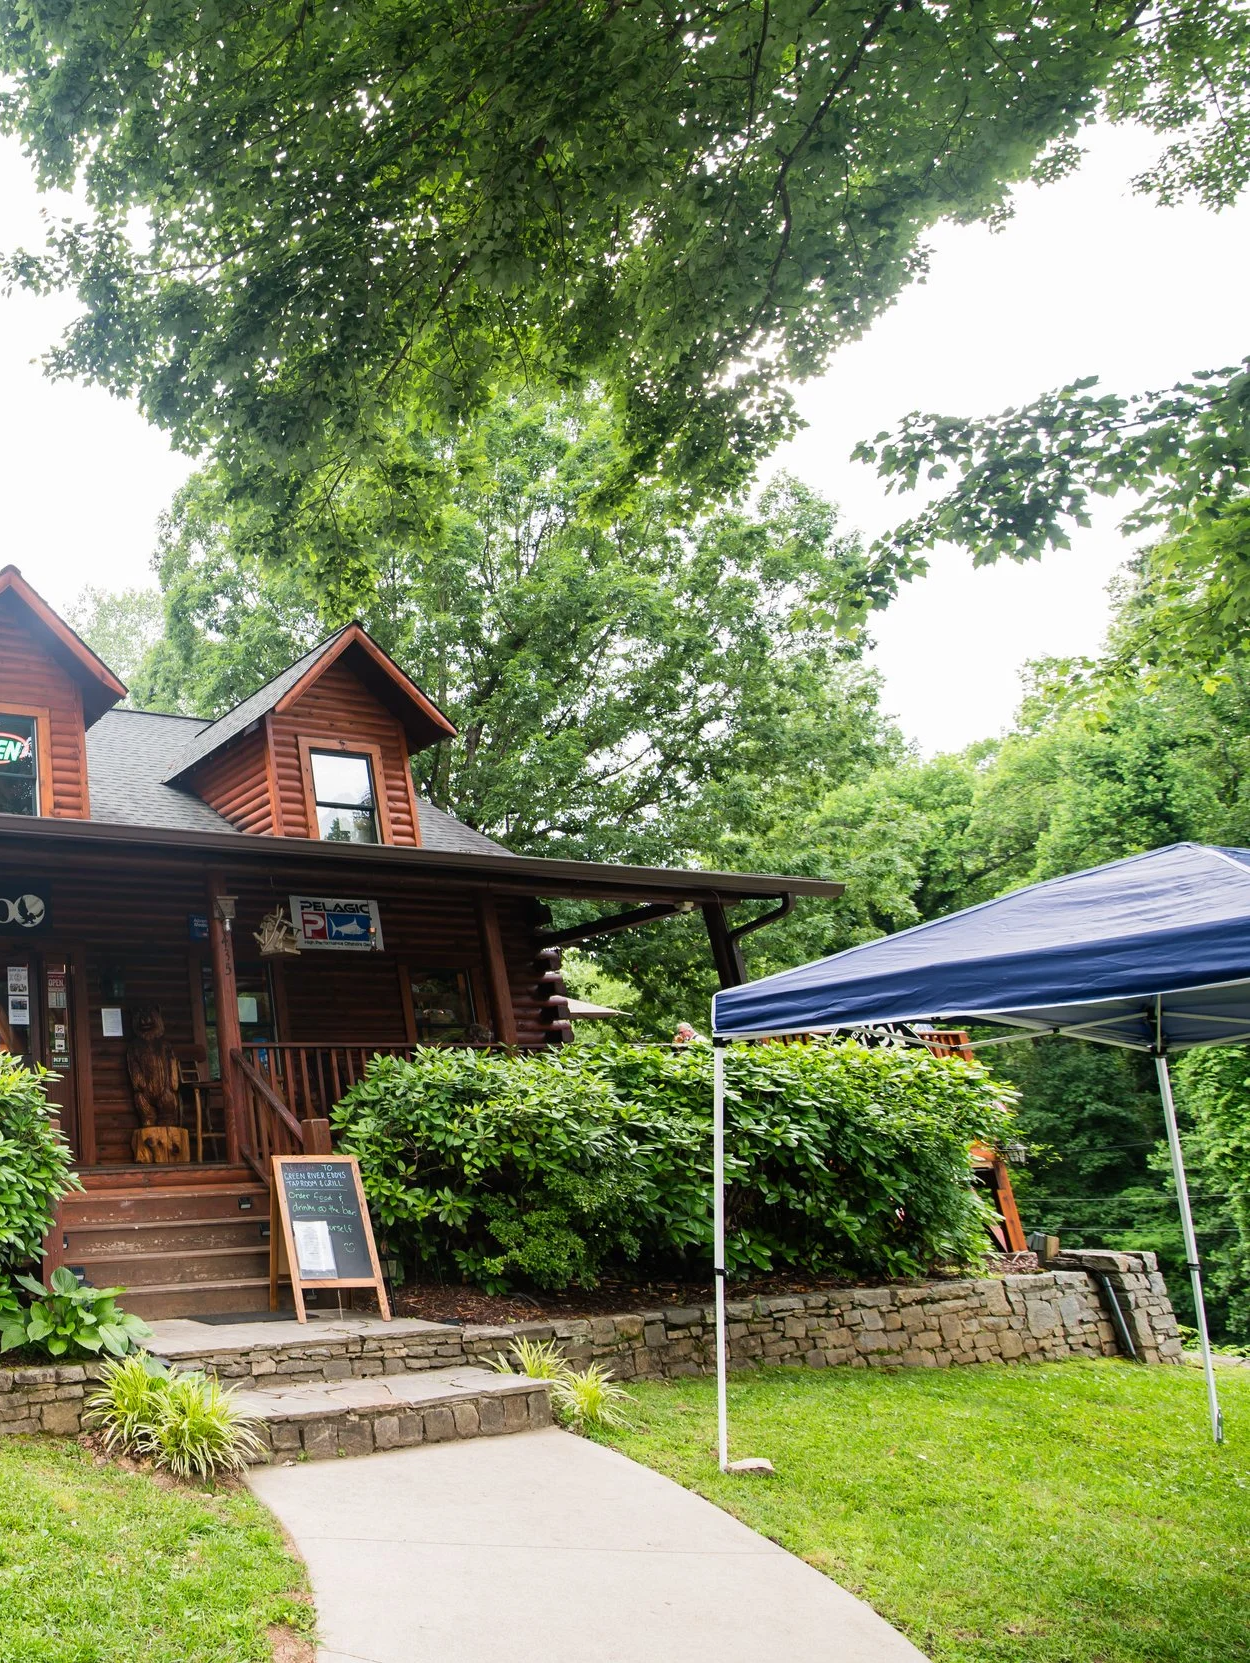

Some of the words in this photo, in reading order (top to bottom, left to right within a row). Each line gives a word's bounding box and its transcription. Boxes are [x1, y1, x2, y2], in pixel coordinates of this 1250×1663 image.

[299, 900, 370, 914] PELAGIC
[284, 1172, 306, 1180] GREEN
[307, 1172, 326, 1180] RIVER
[288, 1191, 310, 1199] Order
[313, 1191, 332, 1201] food
[292, 1203, 316, 1213] drinks
[328, 1204, 339, 1214] the
[328, 1224, 353, 1233] urself
